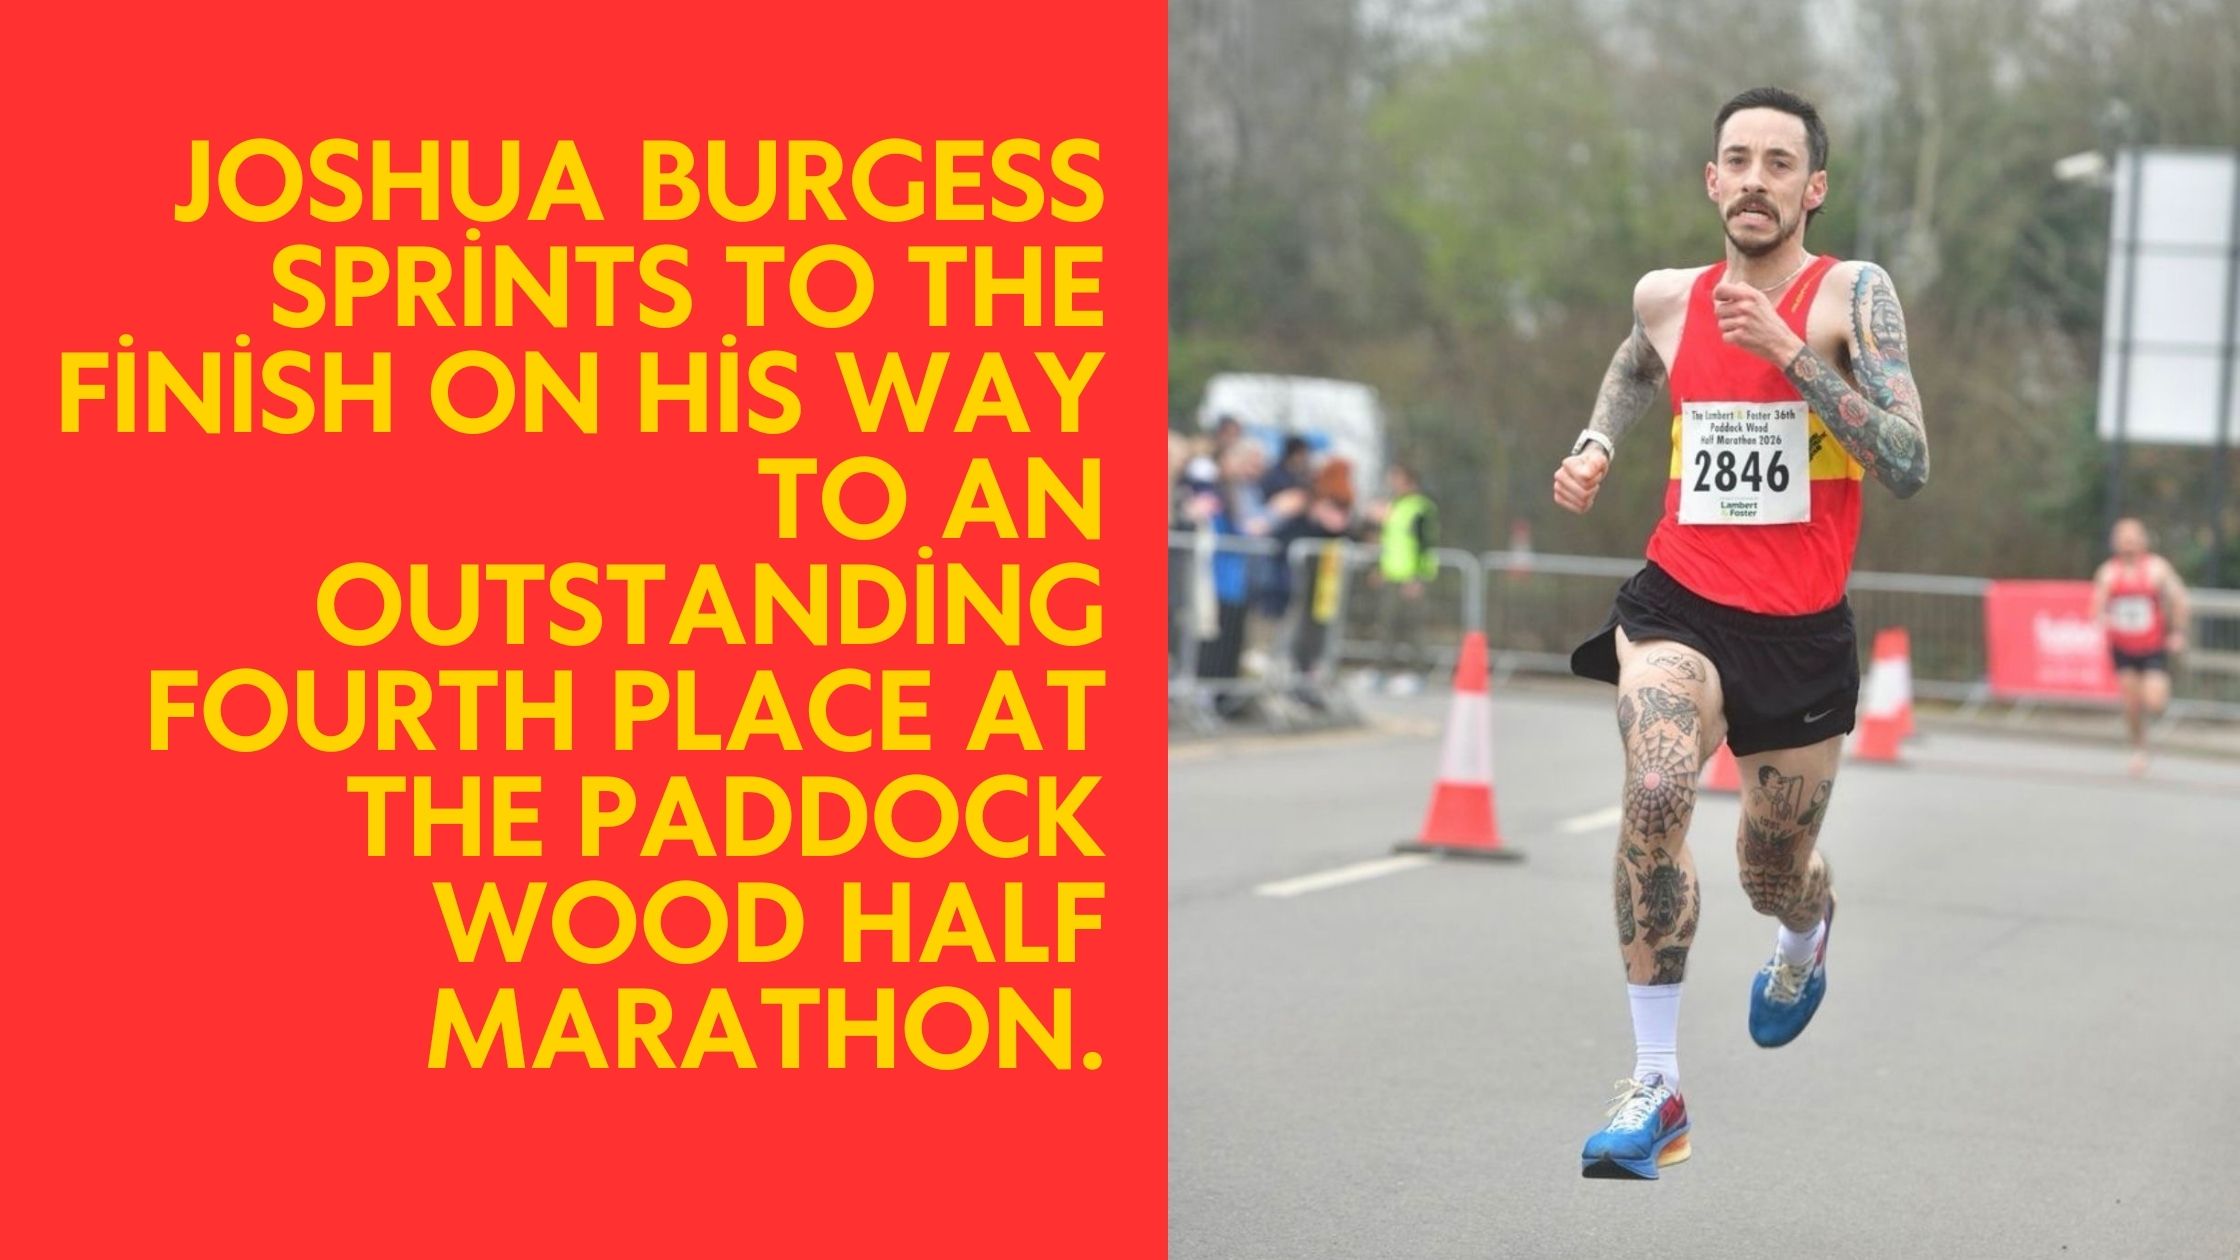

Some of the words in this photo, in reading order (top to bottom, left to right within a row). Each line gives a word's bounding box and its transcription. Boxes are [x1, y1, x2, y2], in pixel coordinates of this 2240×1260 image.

[1692, 410, 1703, 420] The
[1705, 410, 1734, 420] Lambert
[1746, 410, 1771, 420] Foster
[1774, 409, 1796, 420] 36th
[1711, 422, 1743, 432] Paddock
[1746, 422, 1768, 432] Wood
[1701, 435, 1714, 445] Half
[1717, 434, 1757, 445] Marathon
[1759, 434, 1782, 445] 2026
[1693, 450, 1790, 493] 2846
[1721, 501, 1758, 509] Lambert
[1730, 509, 1757, 517] Foster
